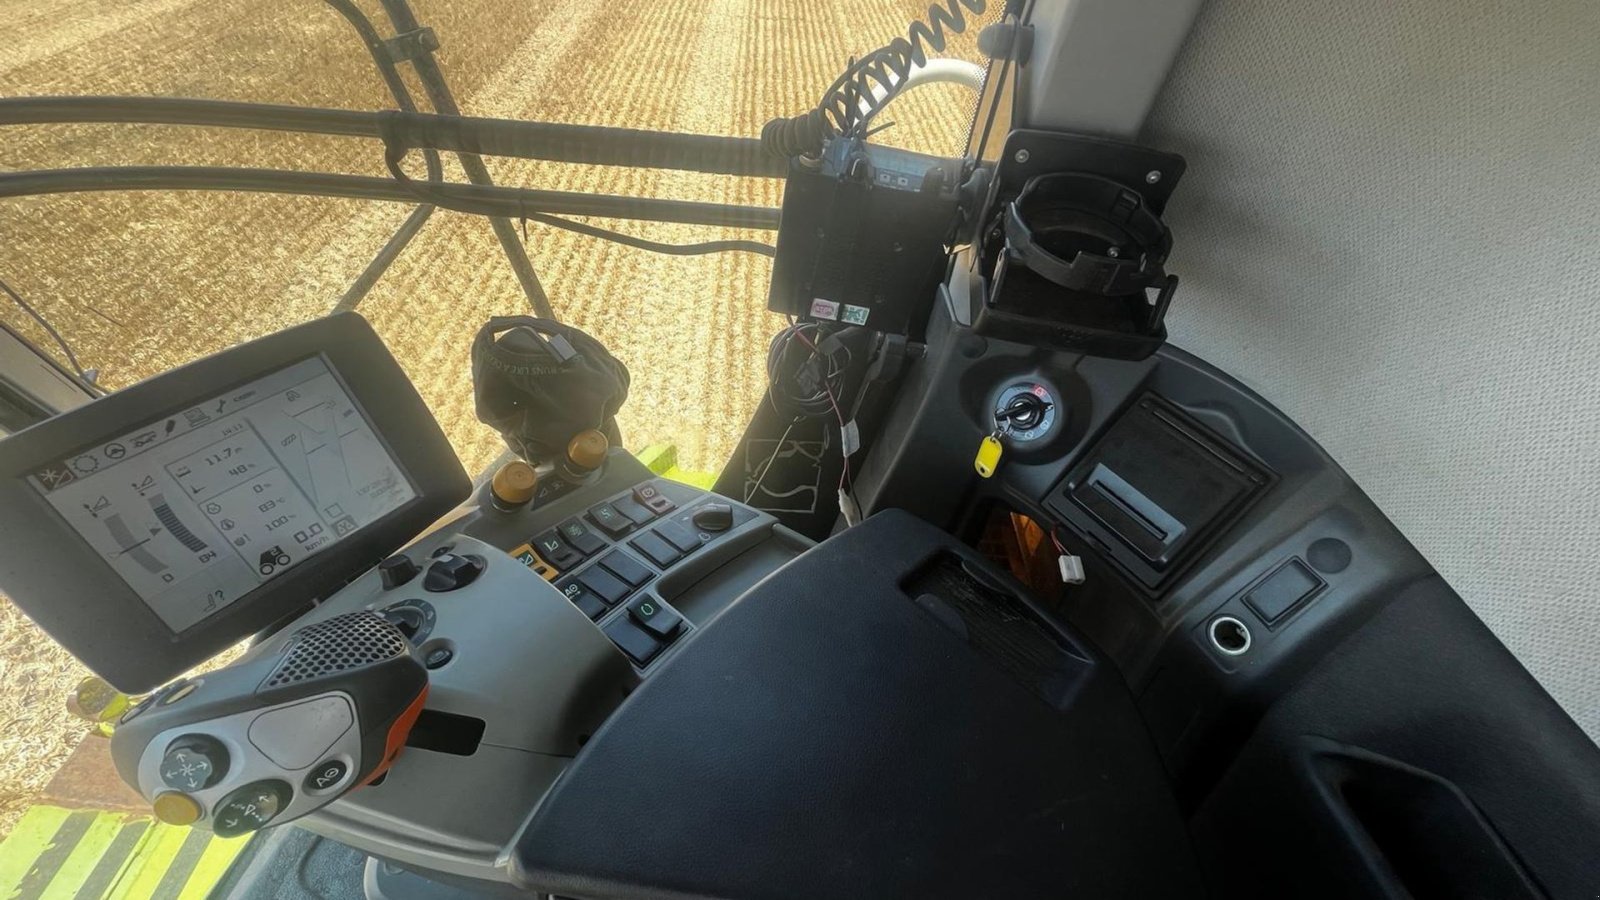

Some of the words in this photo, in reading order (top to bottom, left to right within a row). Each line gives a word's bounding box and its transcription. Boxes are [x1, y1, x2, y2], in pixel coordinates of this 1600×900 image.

[205, 447, 232, 466] 11.7
[265, 515, 289, 531] 100
[293, 522, 323, 544] 0.0
[305, 535, 329, 552] km/h
